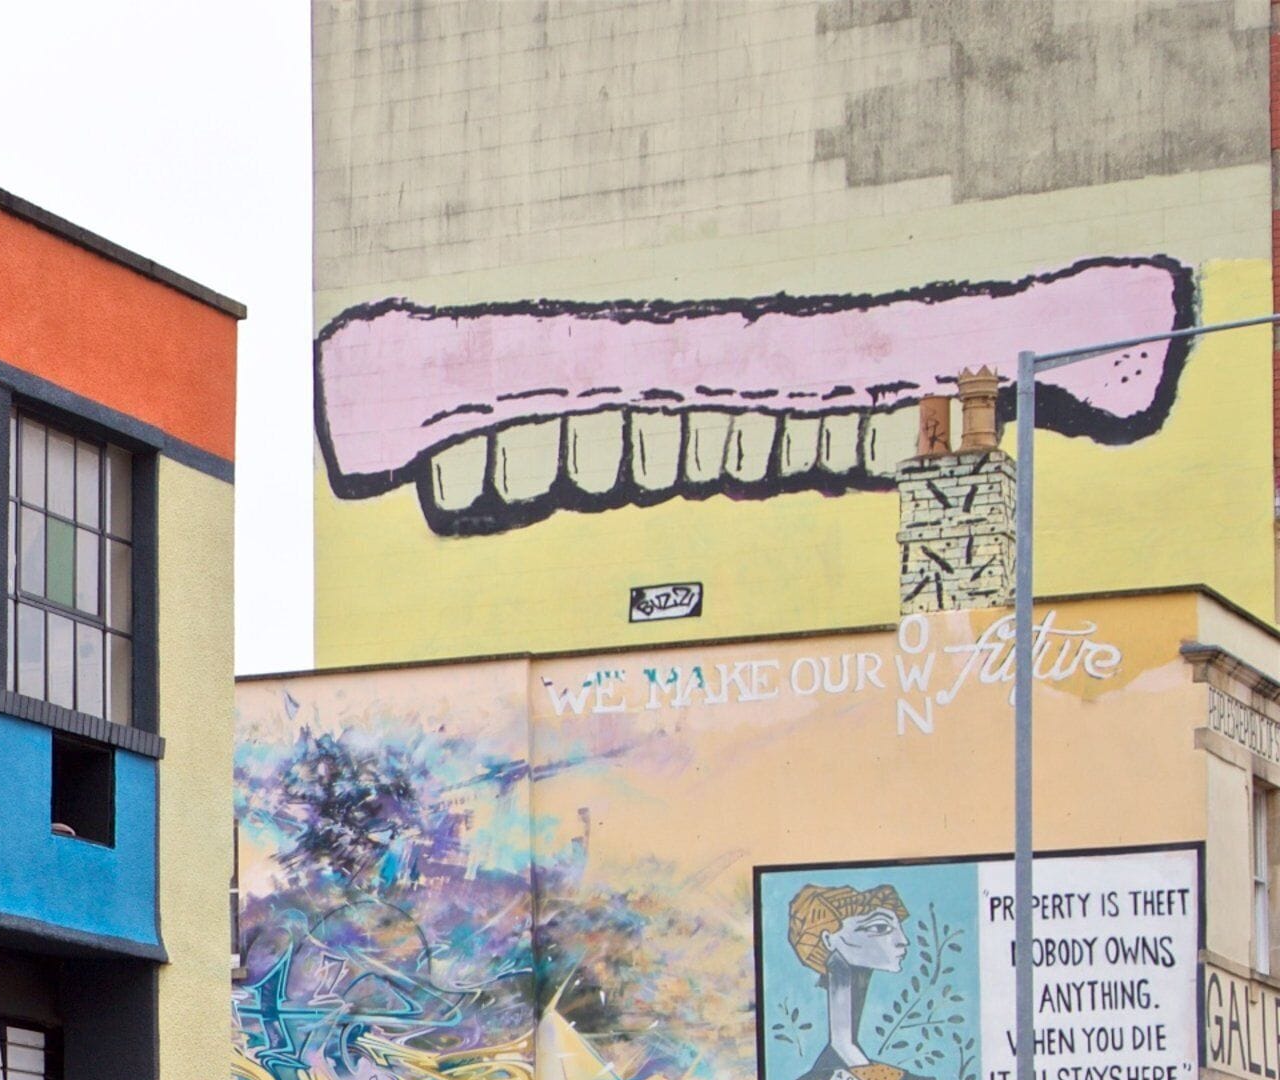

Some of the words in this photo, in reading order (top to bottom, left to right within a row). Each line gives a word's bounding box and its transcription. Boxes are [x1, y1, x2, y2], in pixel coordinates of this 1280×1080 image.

[541, 669, 627, 716] WE
[643, 658, 780, 710] MAKE
[790, 652, 886, 697] OUR
[895, 614, 936, 736] OWN
[1101, 891, 1120, 918] IS
[1129, 888, 1190, 916] THEFT
[1105, 936, 1176, 968] OWNS
[1039, 979, 1160, 1013] ANYTHING.
[1082, 1027, 1124, 1053] YOU
[1133, 1024, 1166, 1051] DIE
